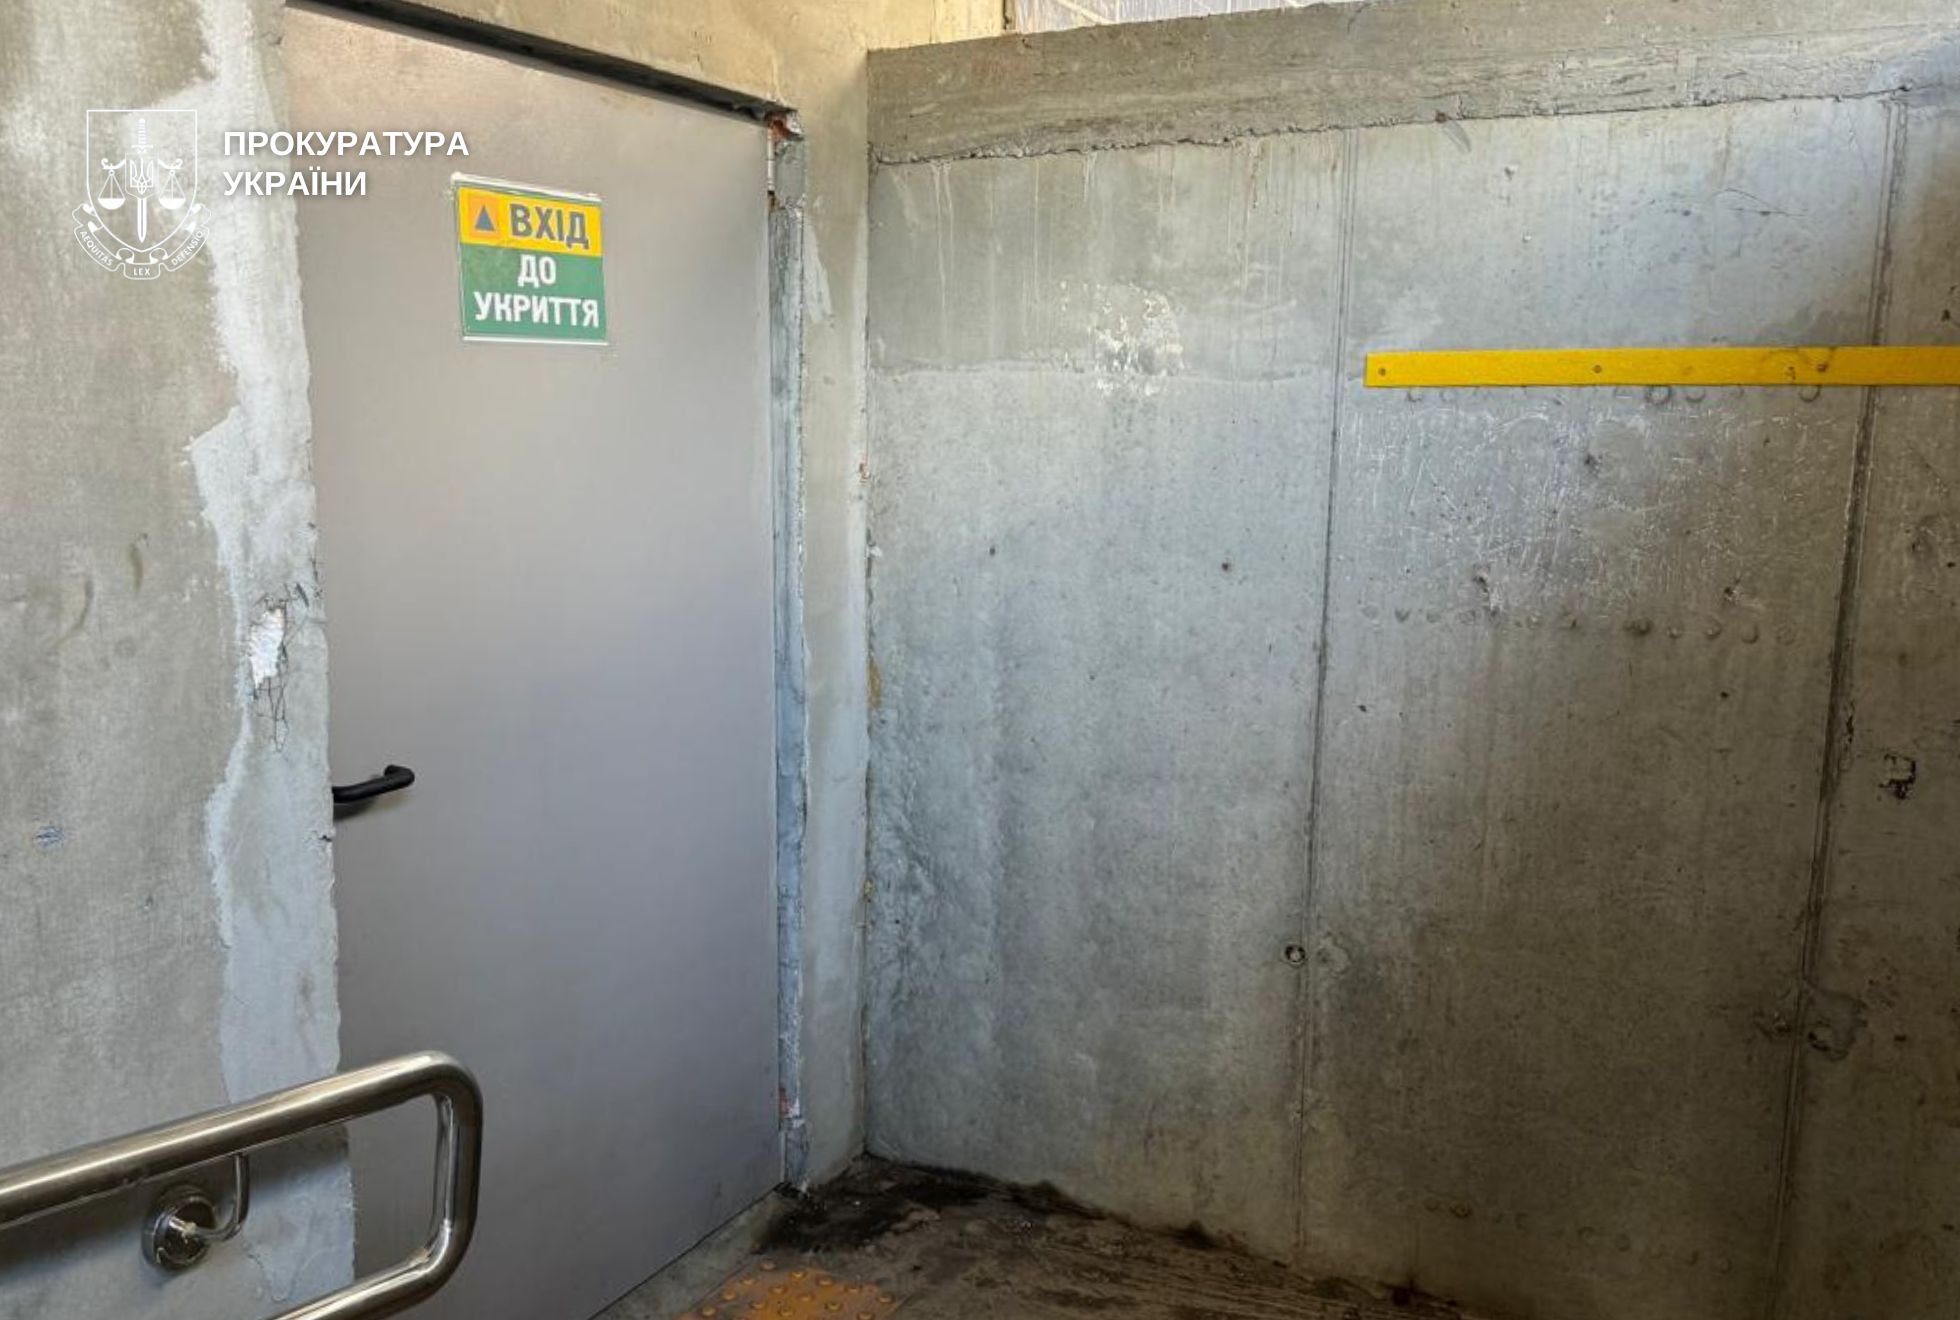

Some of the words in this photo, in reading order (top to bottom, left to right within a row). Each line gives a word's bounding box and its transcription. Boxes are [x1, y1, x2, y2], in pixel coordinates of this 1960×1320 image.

[509, 203, 590, 250] ВХІД
[517, 254, 557, 288] ДО
[473, 291, 600, 328] УКРИТТЯ
